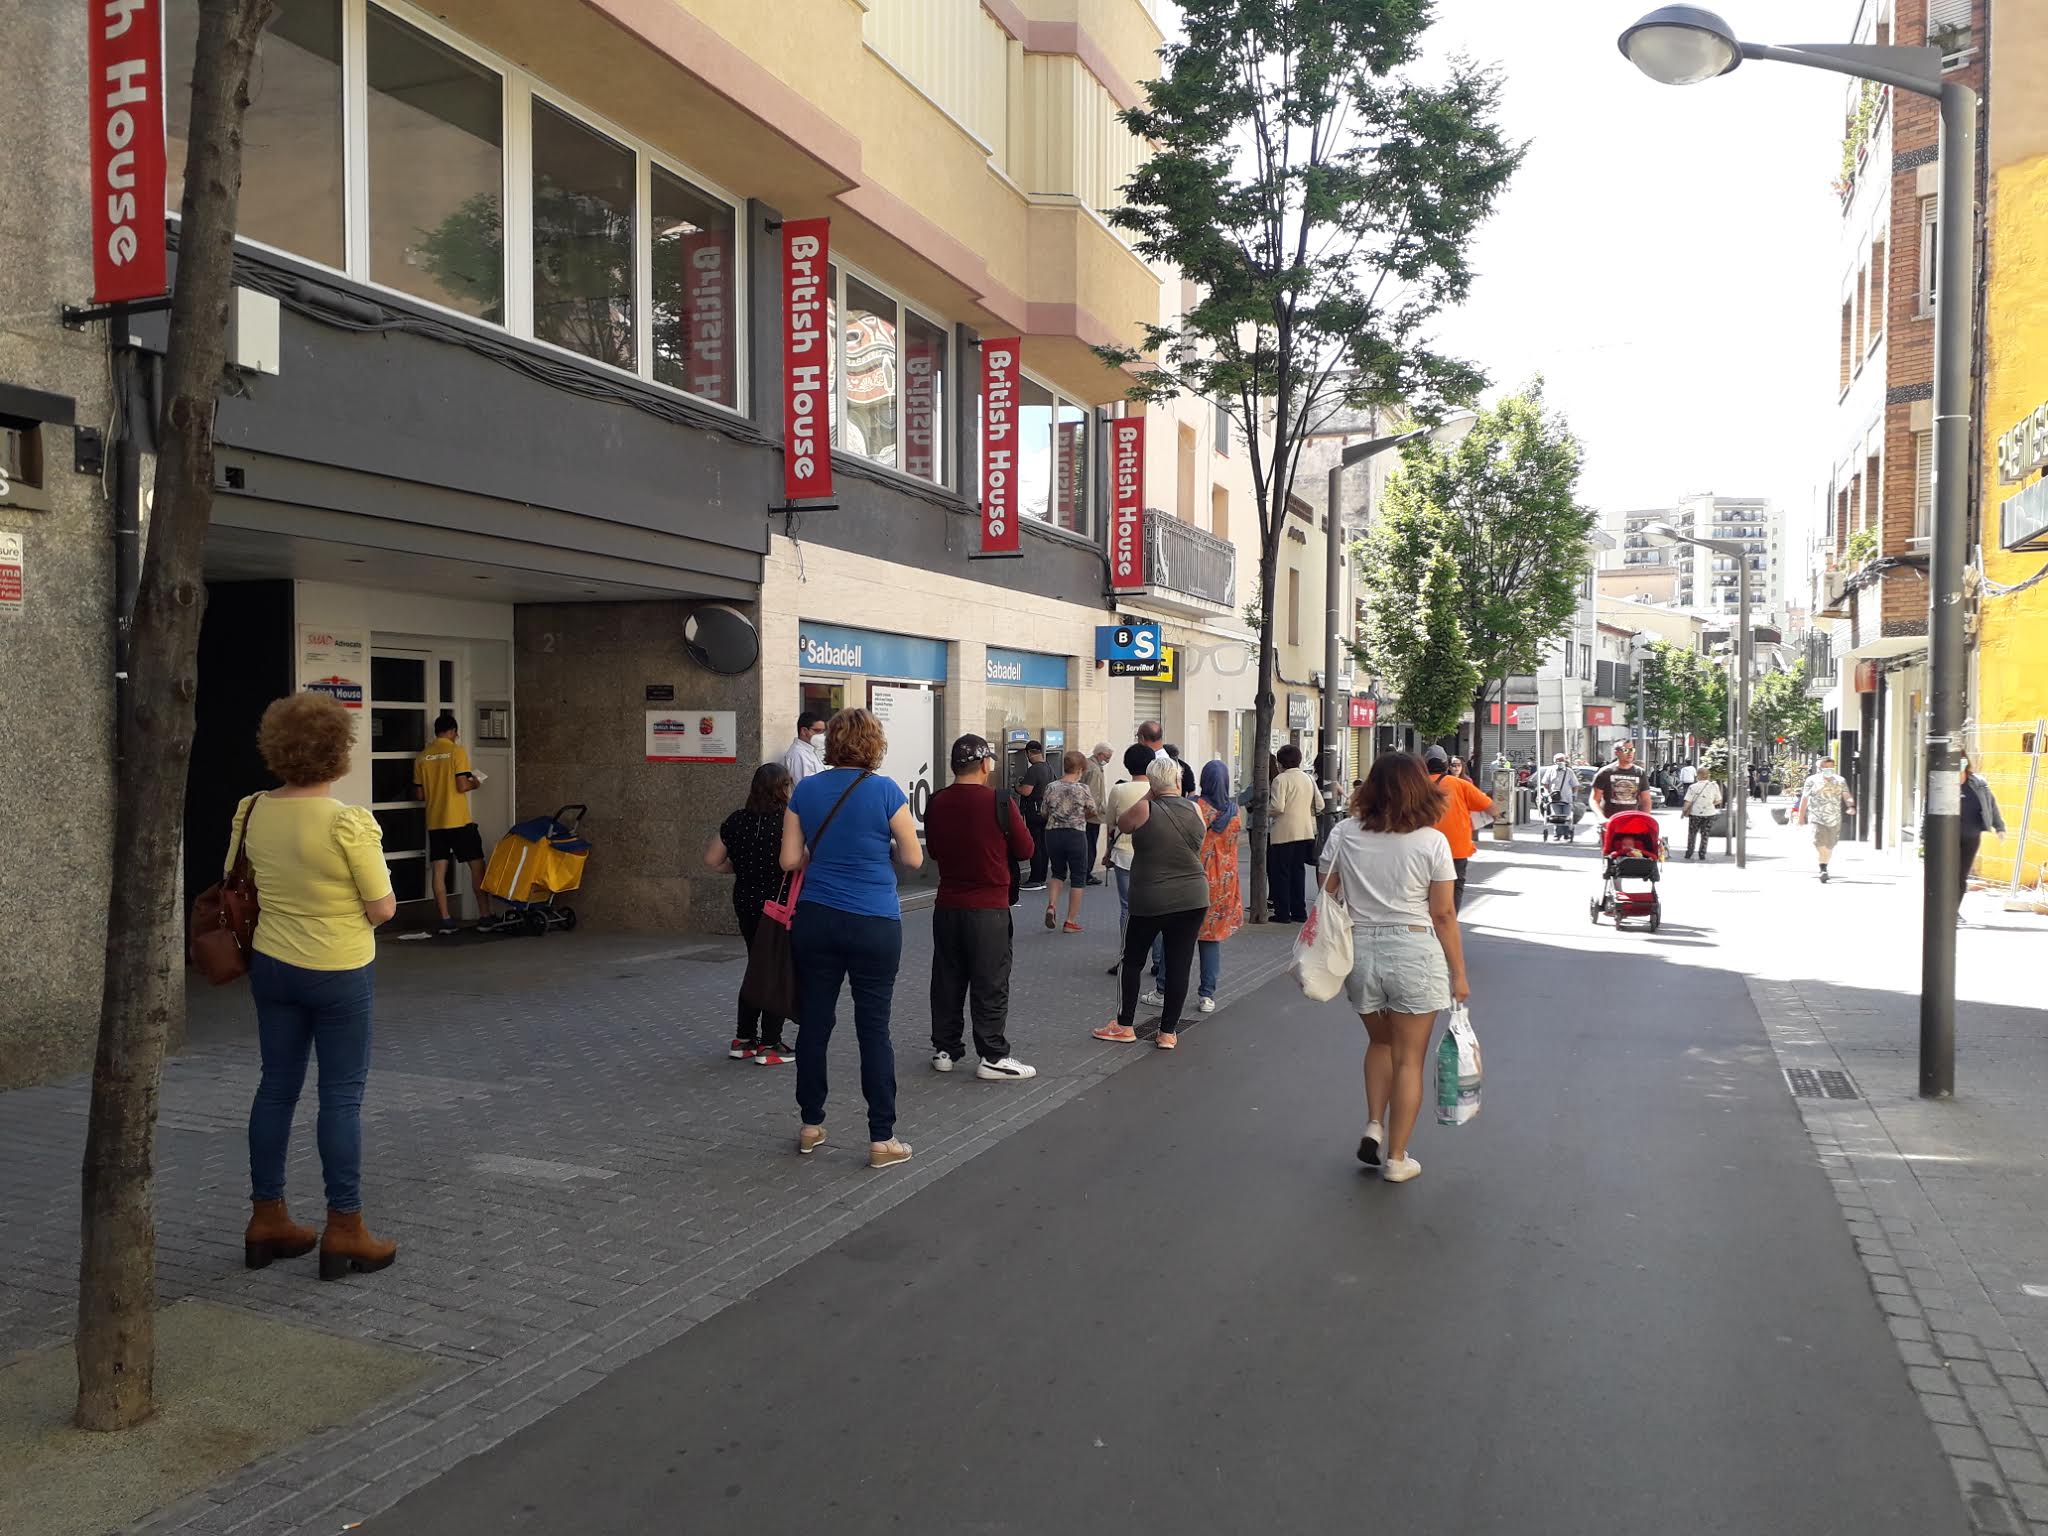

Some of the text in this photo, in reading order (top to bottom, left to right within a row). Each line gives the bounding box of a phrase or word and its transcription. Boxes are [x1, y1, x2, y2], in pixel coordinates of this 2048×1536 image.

[107, 59, 146, 267] House
[791, 236, 821, 479] British House
[989, 350, 1012, 537] British House
[1118, 427, 1138, 576] British House
[807, 639, 862, 668] Sabadell
[986, 660, 1021, 680] Sabadell
[1118, 631, 1155, 658] B S
[1125, 663, 1155, 672] ServiRed
